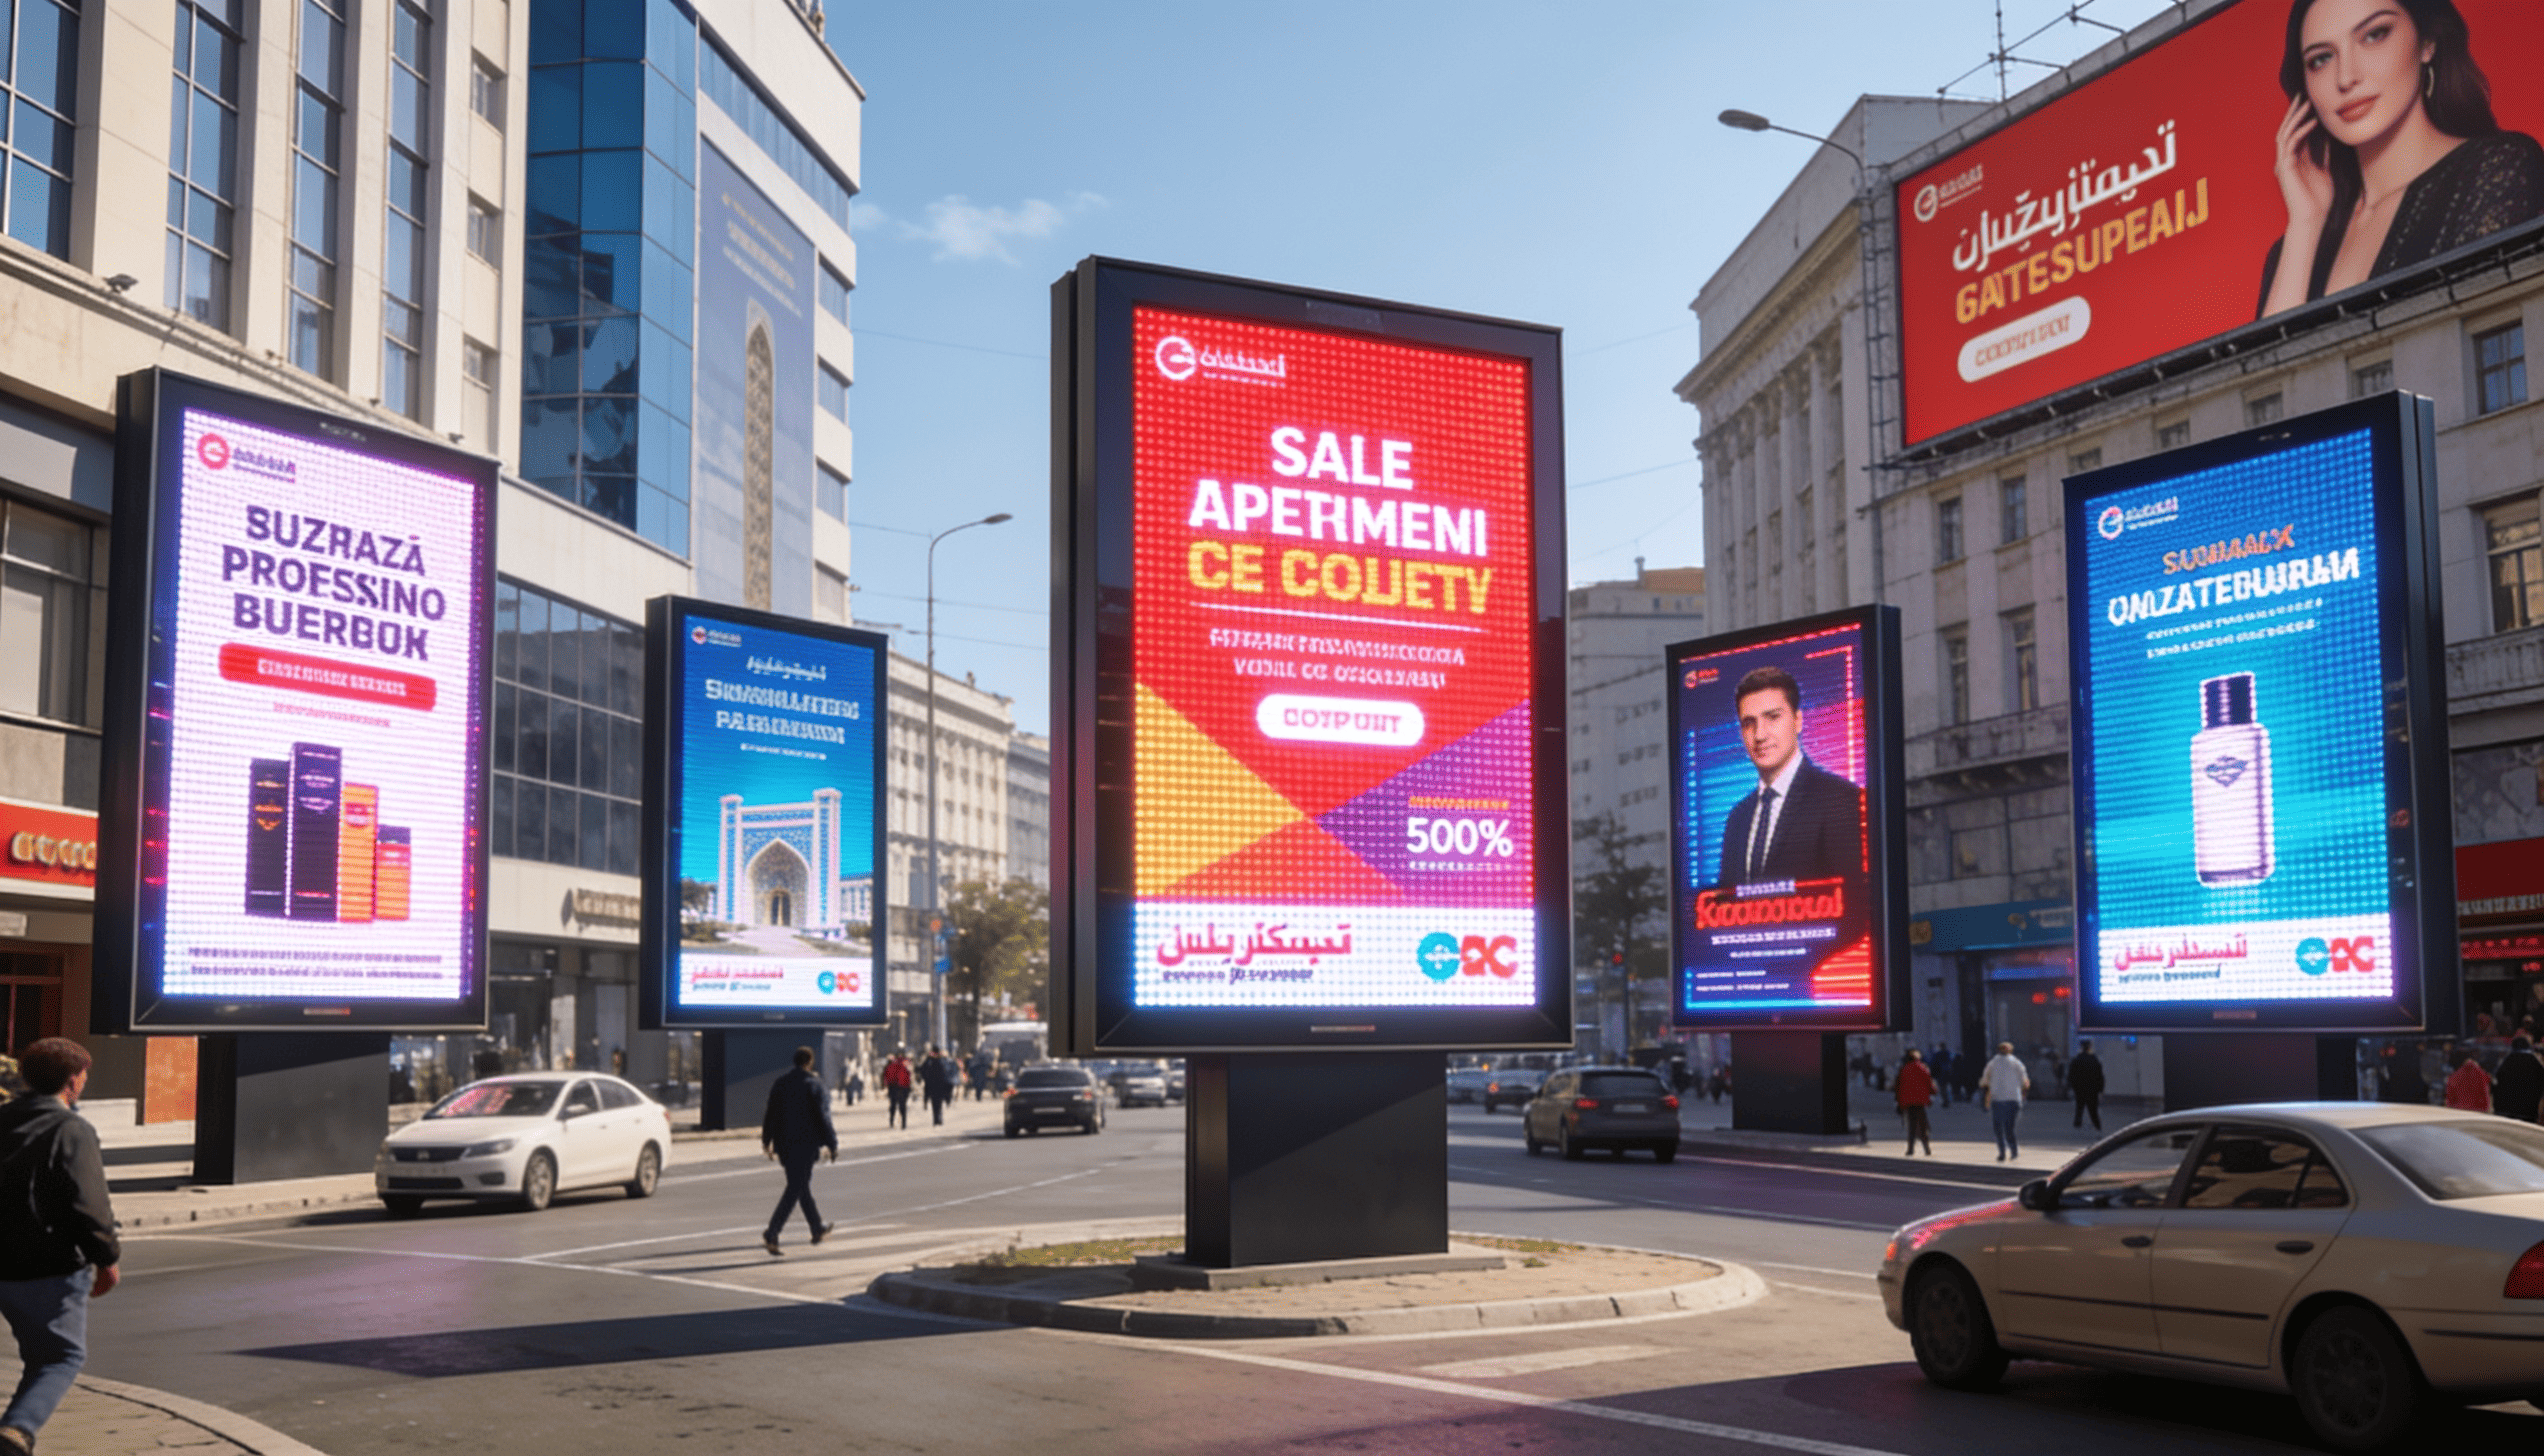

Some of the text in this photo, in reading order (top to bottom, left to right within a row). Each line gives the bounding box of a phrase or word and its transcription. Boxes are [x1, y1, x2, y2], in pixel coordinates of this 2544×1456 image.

[1271, 426, 1414, 490] SALE
[1188, 541, 1265, 593] CE
[1407, 816, 1514, 858] 500%
